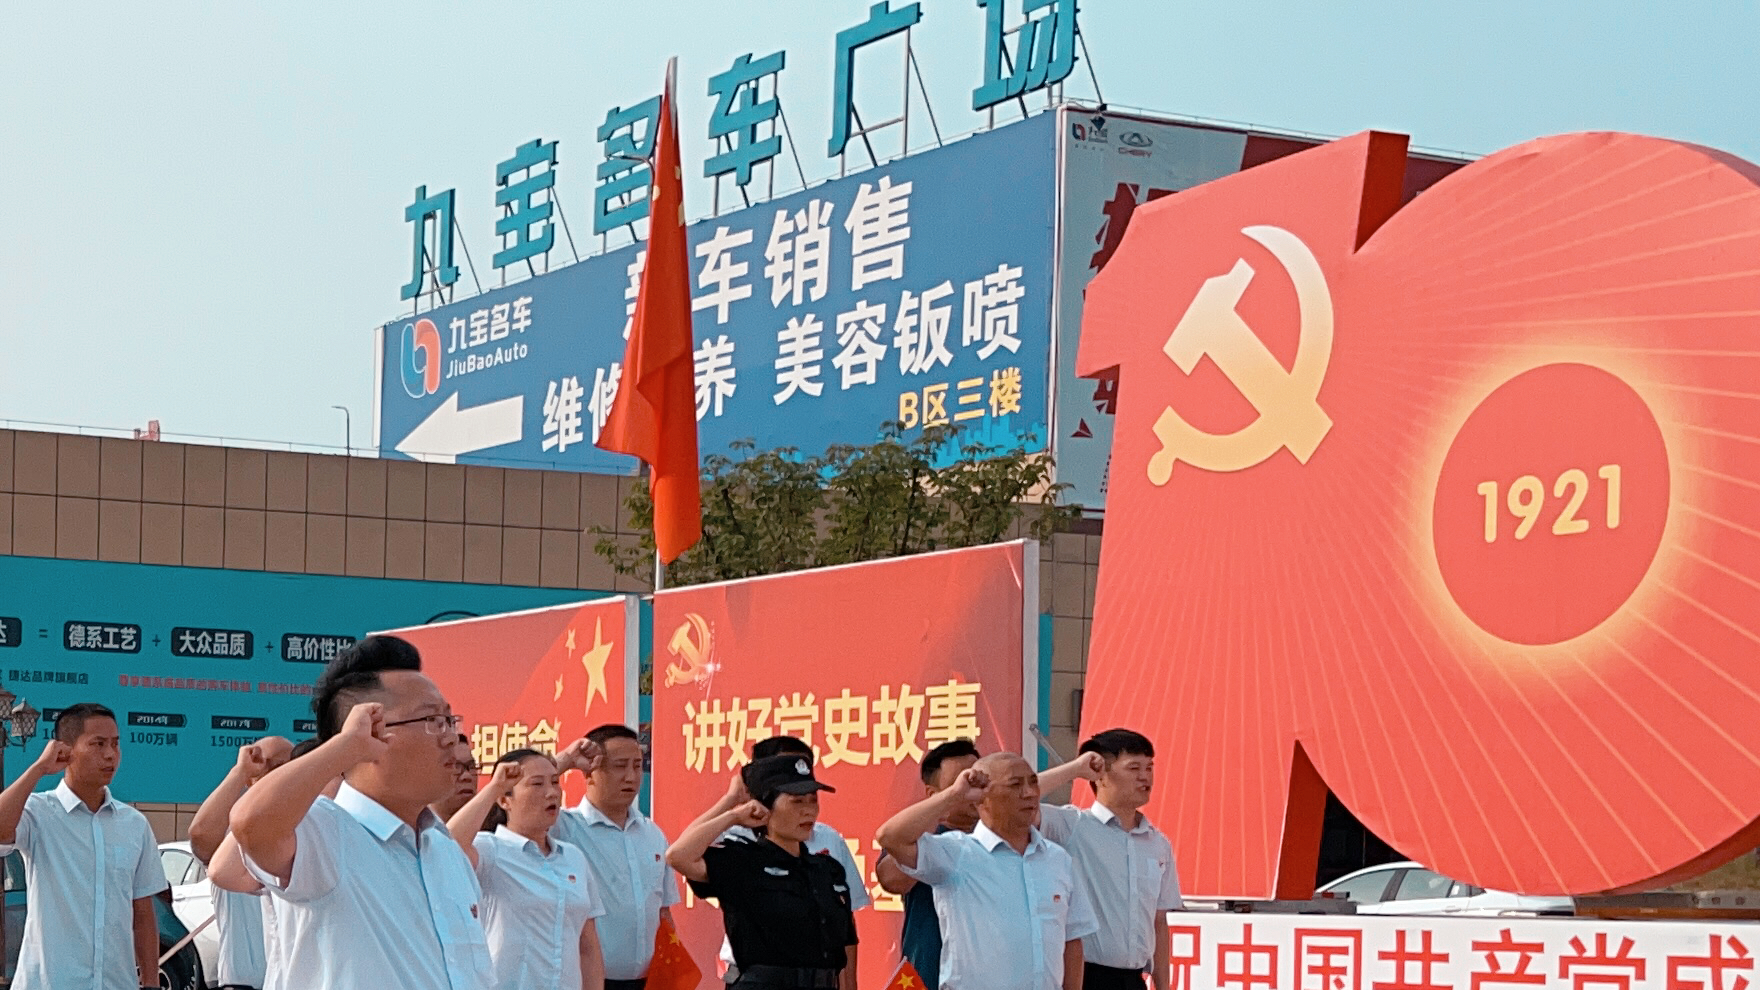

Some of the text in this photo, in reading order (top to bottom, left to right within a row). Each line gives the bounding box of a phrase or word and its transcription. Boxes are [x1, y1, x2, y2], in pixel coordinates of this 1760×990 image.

[447, 296, 533, 354] 九宝名车
[446, 342, 528, 379] JiuBaoAuto
[541, 335, 737, 453] 维修养
[773, 263, 1026, 406] 美容钣喷
[898, 366, 1023, 430] B区三楼
[1477, 464, 1621, 543] 1921
[68, 623, 138, 651] 德系工艺
[179, 630, 246, 657] 大众品质
